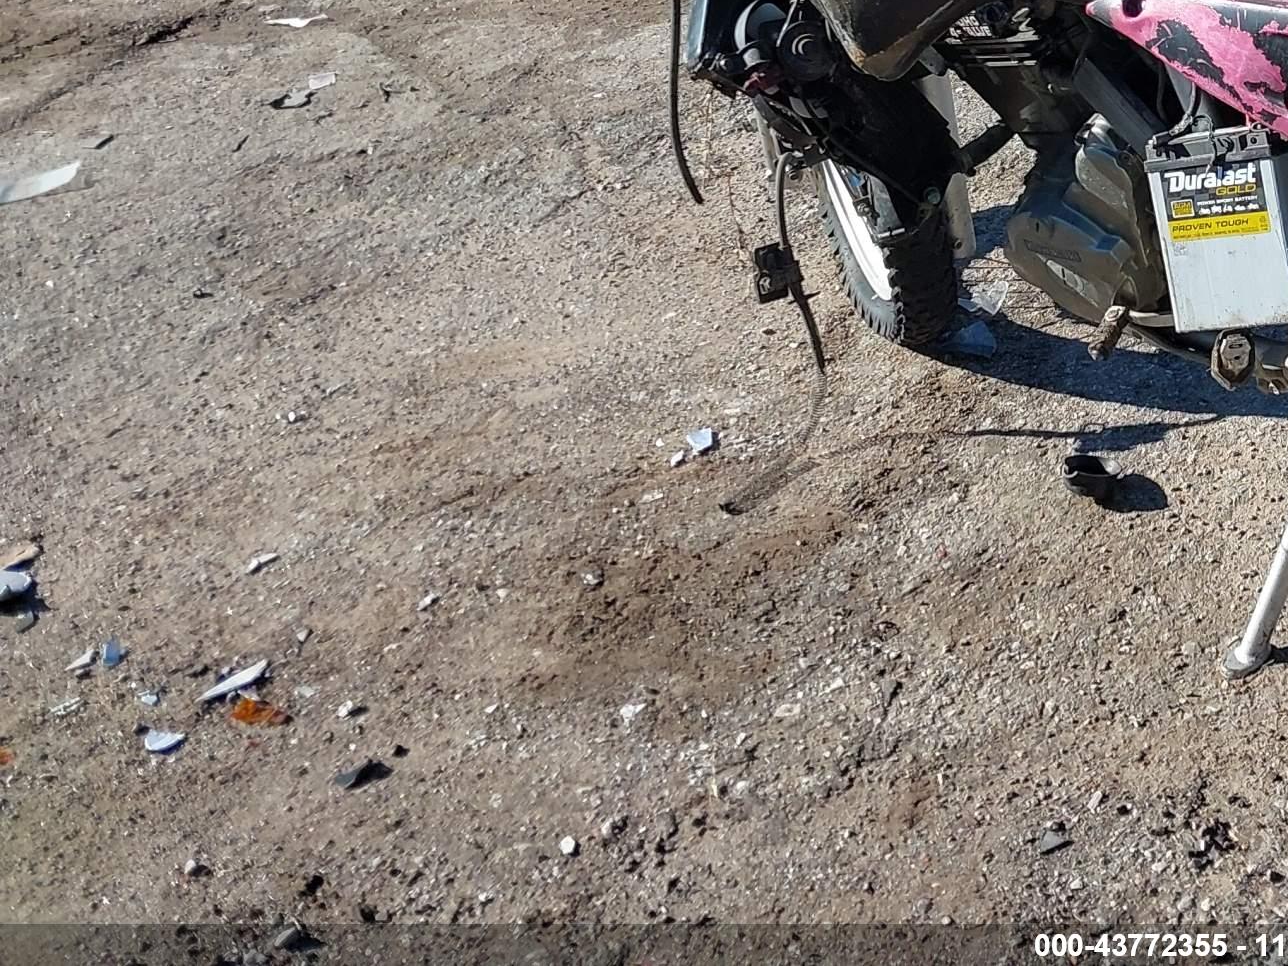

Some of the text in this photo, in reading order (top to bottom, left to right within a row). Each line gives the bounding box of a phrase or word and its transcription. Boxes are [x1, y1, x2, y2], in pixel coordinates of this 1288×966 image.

[1164, 162, 1256, 193] Duralast
[1216, 184, 1256, 196] GOLD
[1172, 222, 1212, 232] PROVEN
[1215, 218, 1249, 228] TOUGH
